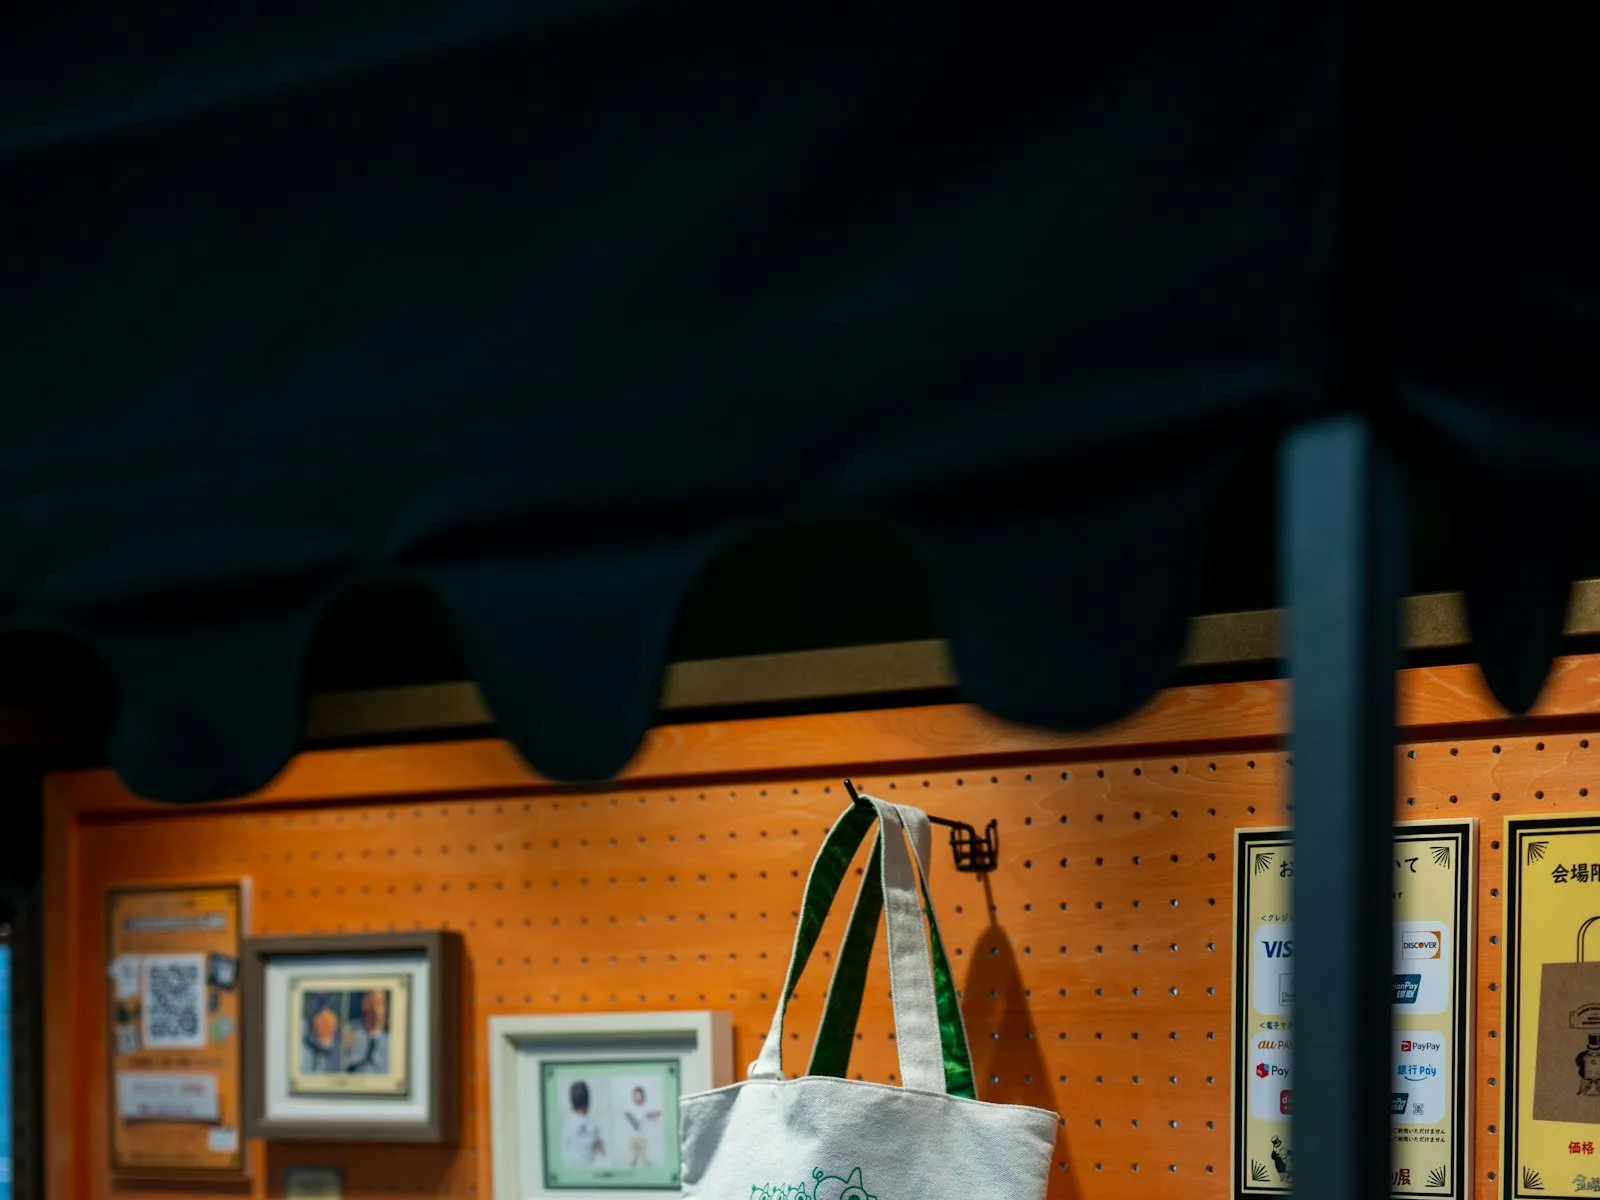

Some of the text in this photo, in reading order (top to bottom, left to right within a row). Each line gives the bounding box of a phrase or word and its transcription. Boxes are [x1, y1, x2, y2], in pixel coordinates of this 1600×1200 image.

[1279, 860, 1294, 878] お
[1261, 941, 1294, 958] VIS
[1403, 941, 1438, 950] DISCOVER
[1278, 1040, 1293, 1050] PA
[1412, 1042, 1441, 1052] PayPay
[1271, 1065, 1290, 1078] Pay
[1569, 1140, 1595, 1155] 価格
